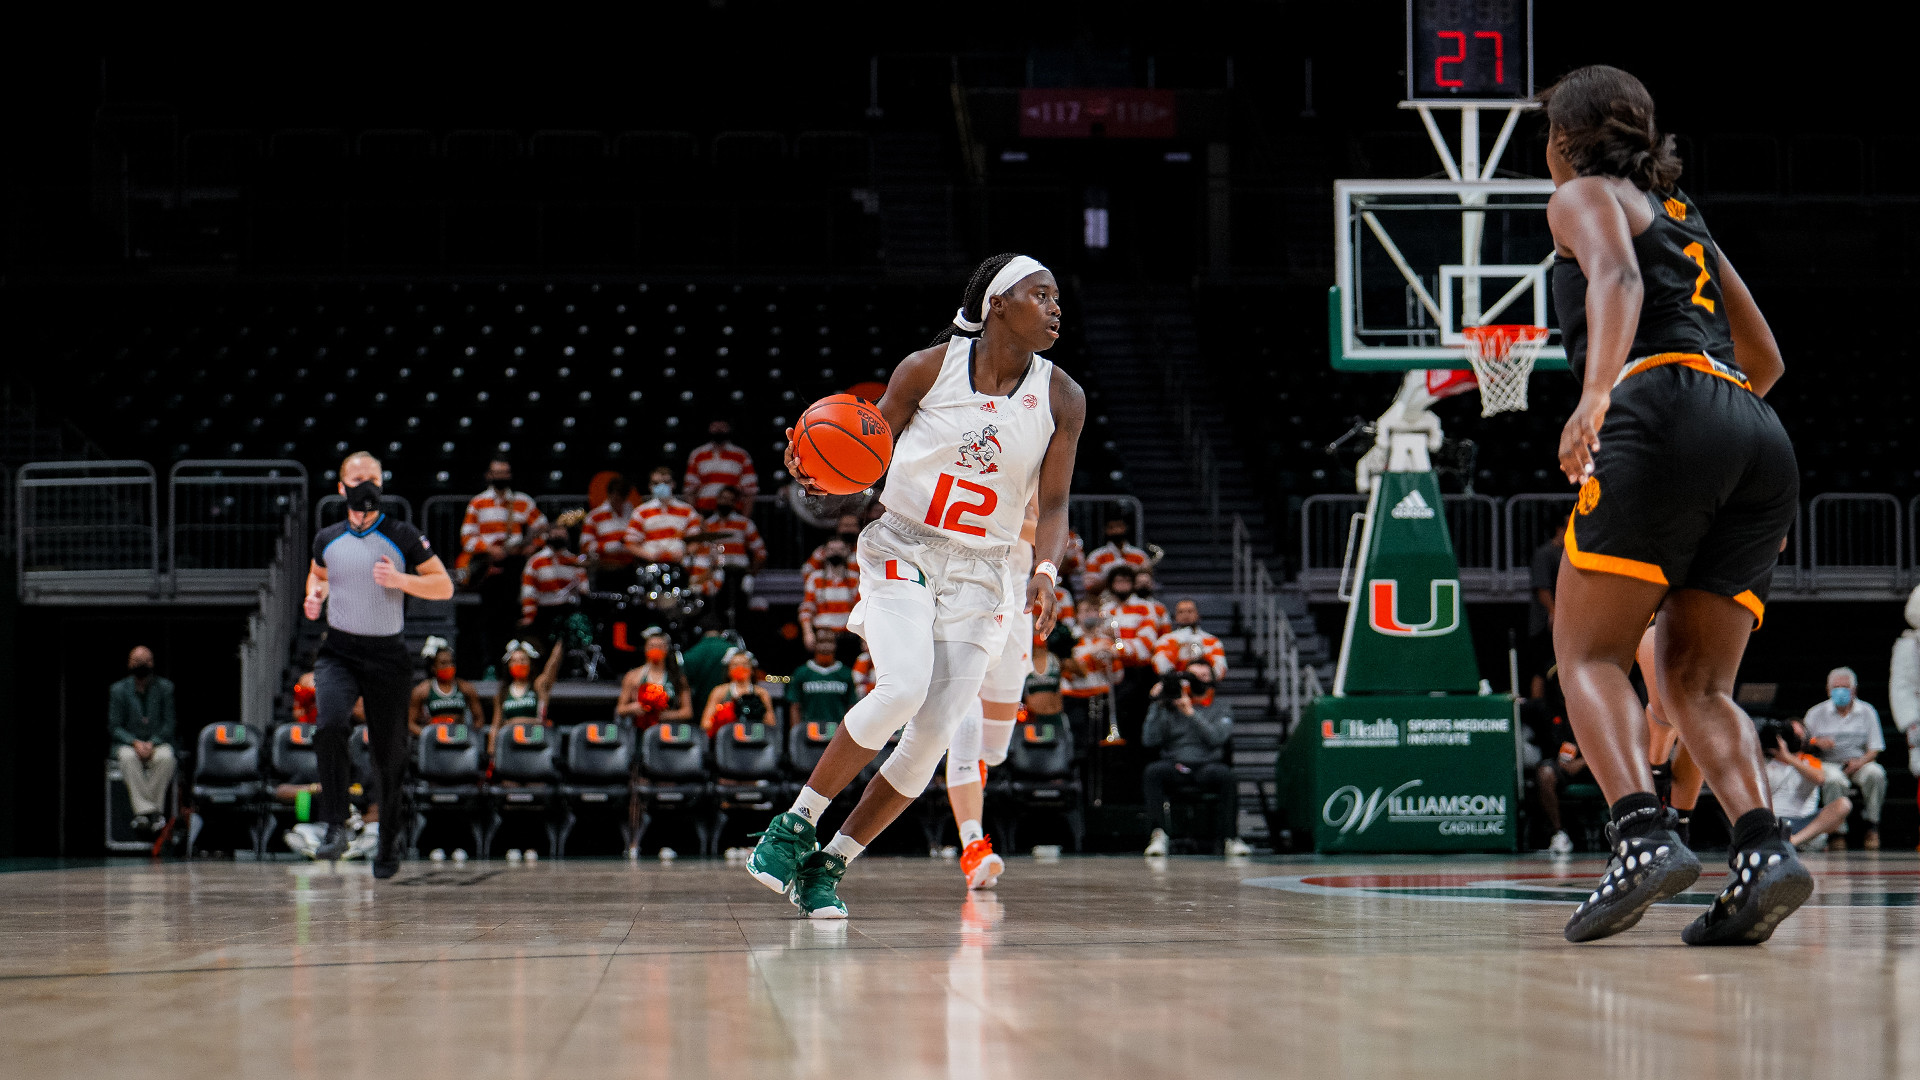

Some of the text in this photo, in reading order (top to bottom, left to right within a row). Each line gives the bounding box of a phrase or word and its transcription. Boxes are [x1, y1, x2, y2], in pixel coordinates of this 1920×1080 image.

[1434, 31, 1503, 87] 27
[1683, 241, 1715, 314] 2
[857, 409, 885, 434] adidas
[980, 404, 998, 414] adidas
[924, 472, 998, 537] 12
[1369, 578, 1460, 637] U
[1407, 718, 1510, 732] SPORTS MEDICINE
[1407, 732, 1472, 746] INSTITUTE
[1322, 779, 1507, 834] WILLIAMSON
[1438, 820, 1506, 836] CADILLAC
